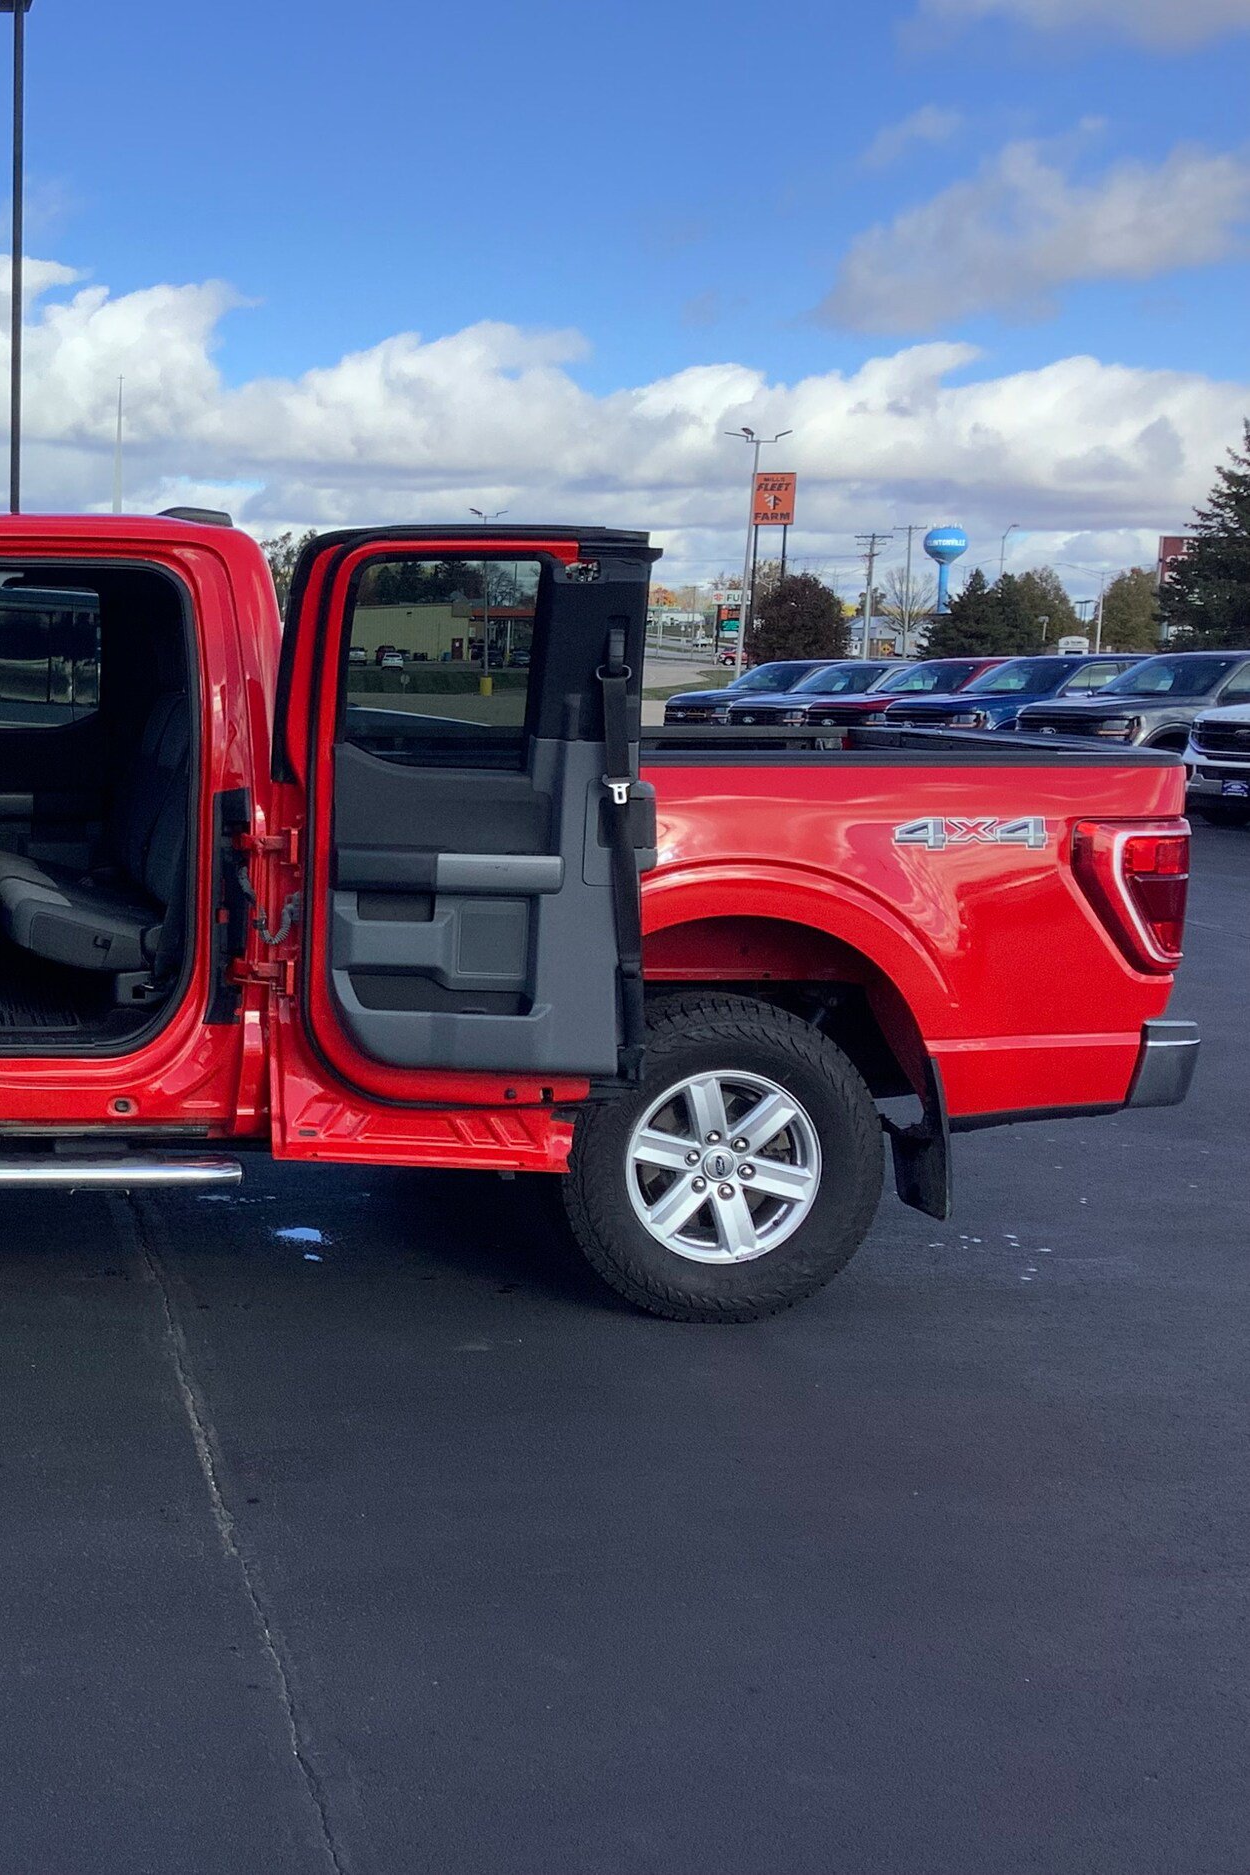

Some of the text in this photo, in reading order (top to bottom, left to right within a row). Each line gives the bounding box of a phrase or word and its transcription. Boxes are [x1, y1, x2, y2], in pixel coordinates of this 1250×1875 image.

[756, 482, 791, 492] FLEET
[754, 512, 791, 521] FARM
[726, 593, 751, 602] FUL
